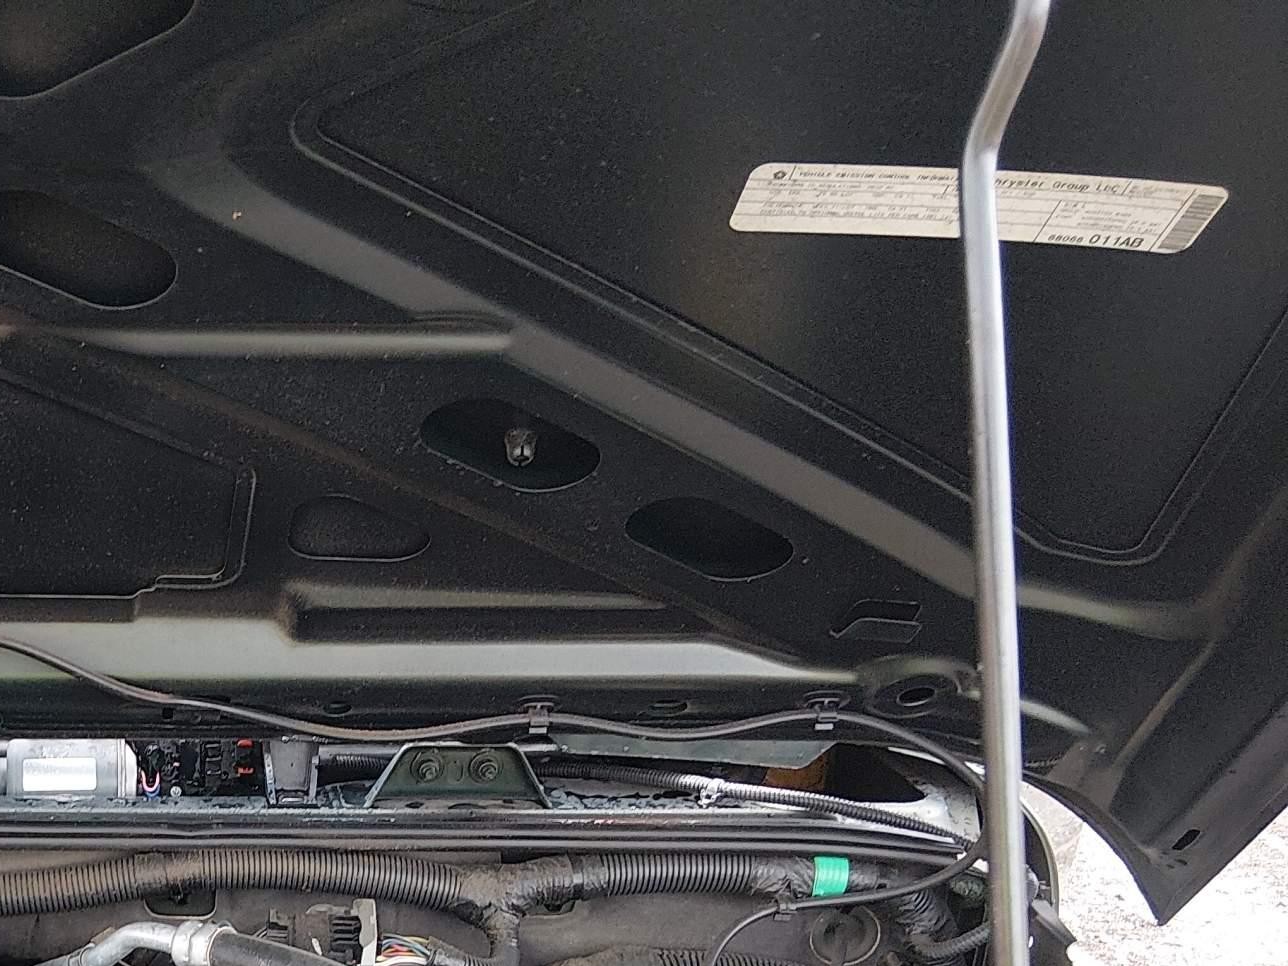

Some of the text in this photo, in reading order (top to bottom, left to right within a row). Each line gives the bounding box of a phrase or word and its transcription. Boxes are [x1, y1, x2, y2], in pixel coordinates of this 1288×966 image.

[994, 177, 1044, 189] hrysler
[1053, 180, 1090, 193] Group
[1089, 233, 1145, 248] 011AB
